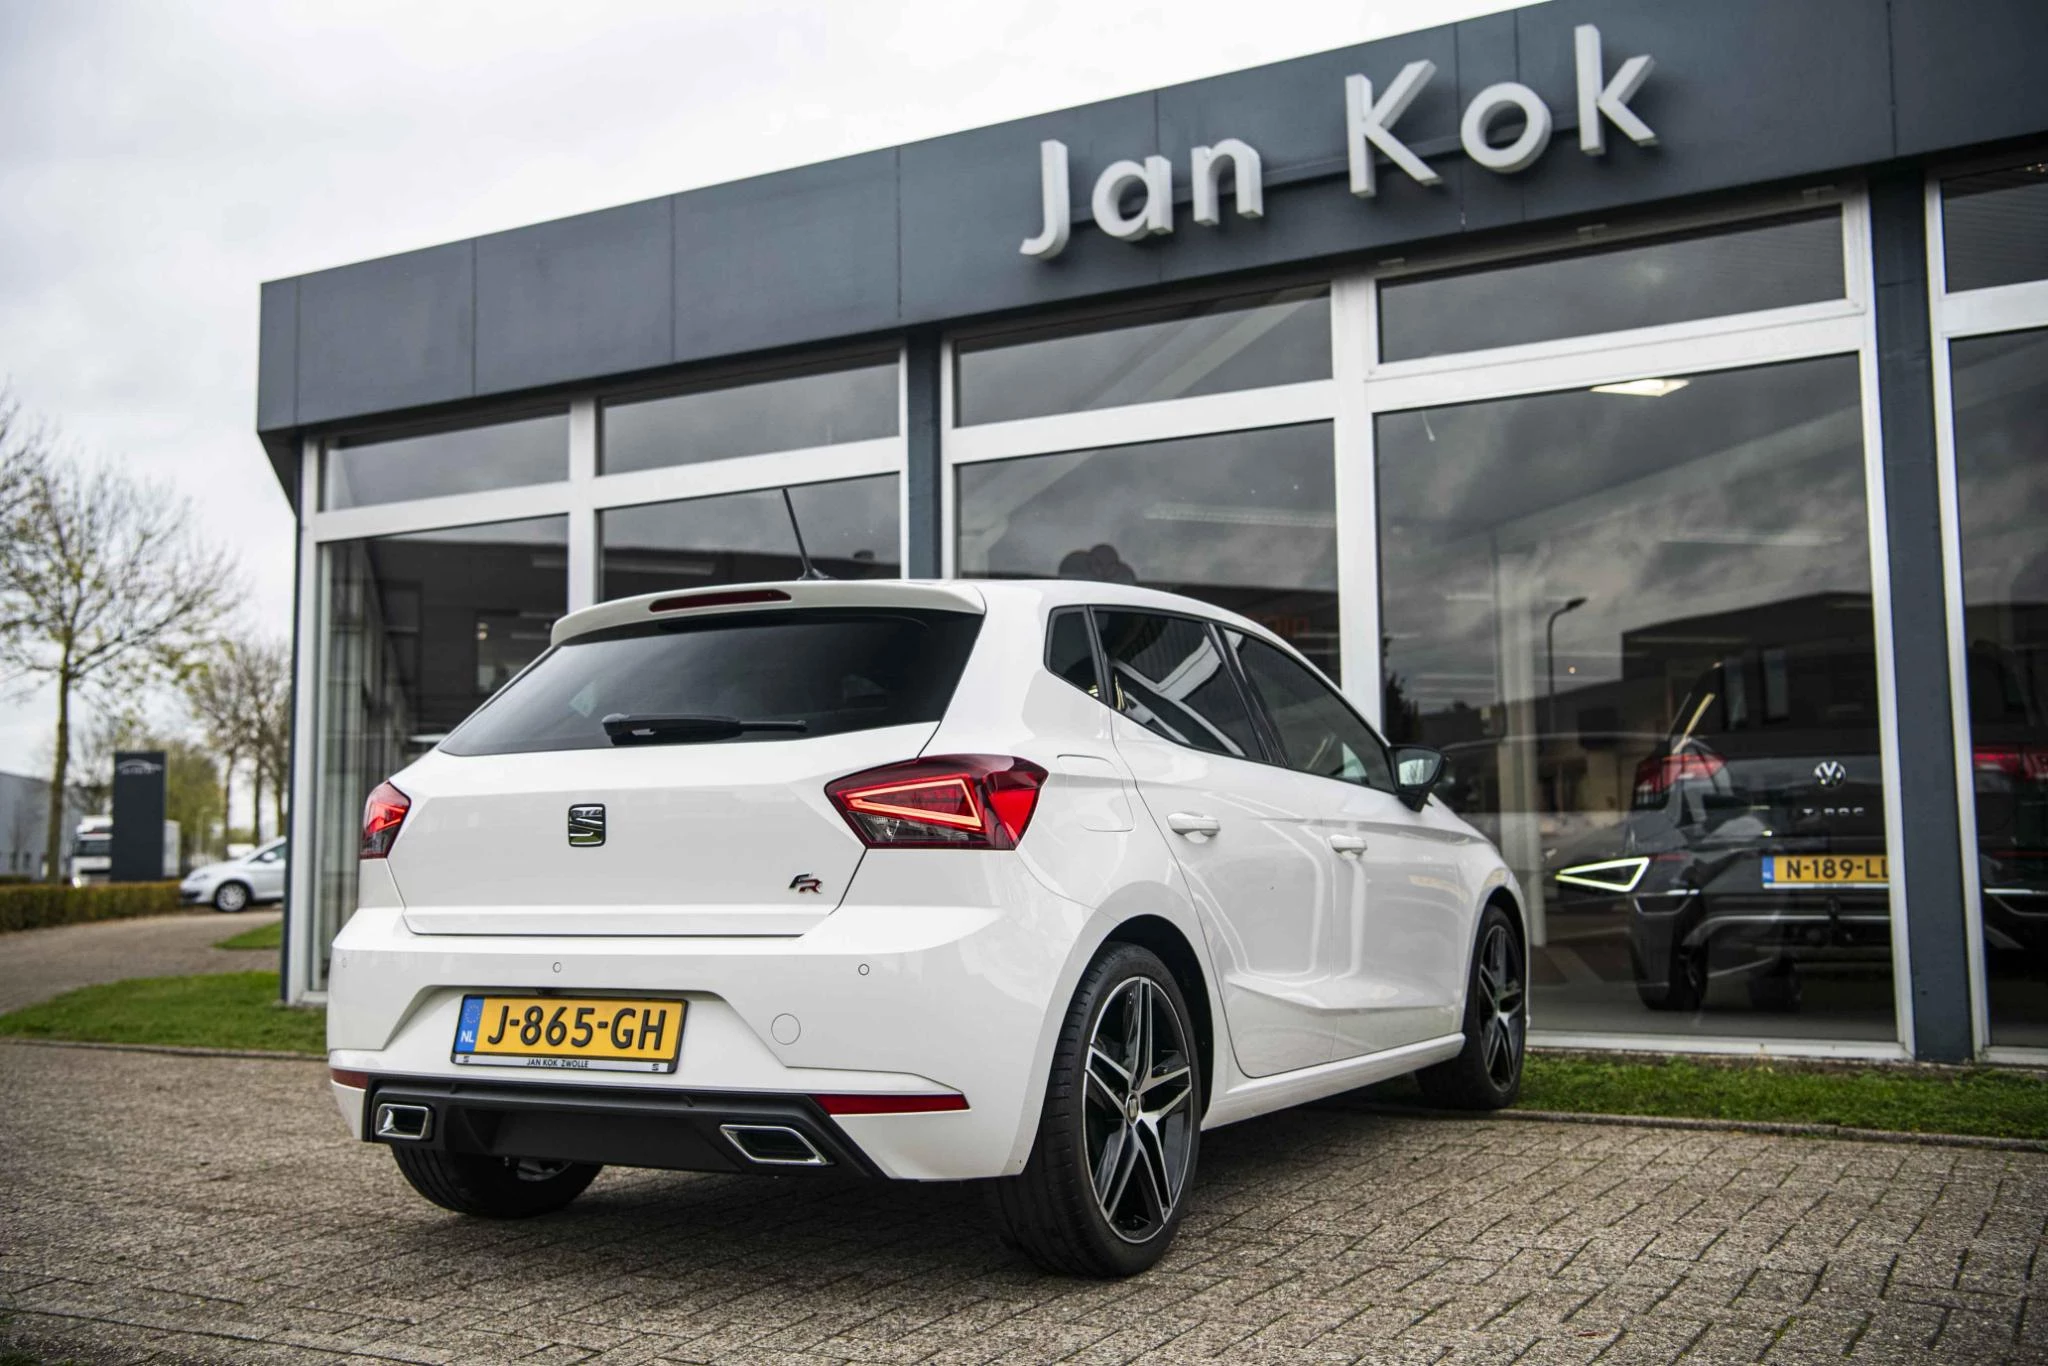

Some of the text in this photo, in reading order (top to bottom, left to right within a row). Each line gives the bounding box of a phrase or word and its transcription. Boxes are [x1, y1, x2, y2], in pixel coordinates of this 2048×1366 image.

[1020, 23, 1658, 260] Jan Kok
[788, 873, 823, 894] FR
[460, 1031, 475, 1043] NL
[487, 1005, 667, 1051] J-865-GH
[526, 1058, 589, 1069] JAN KOK ZWOLLE
